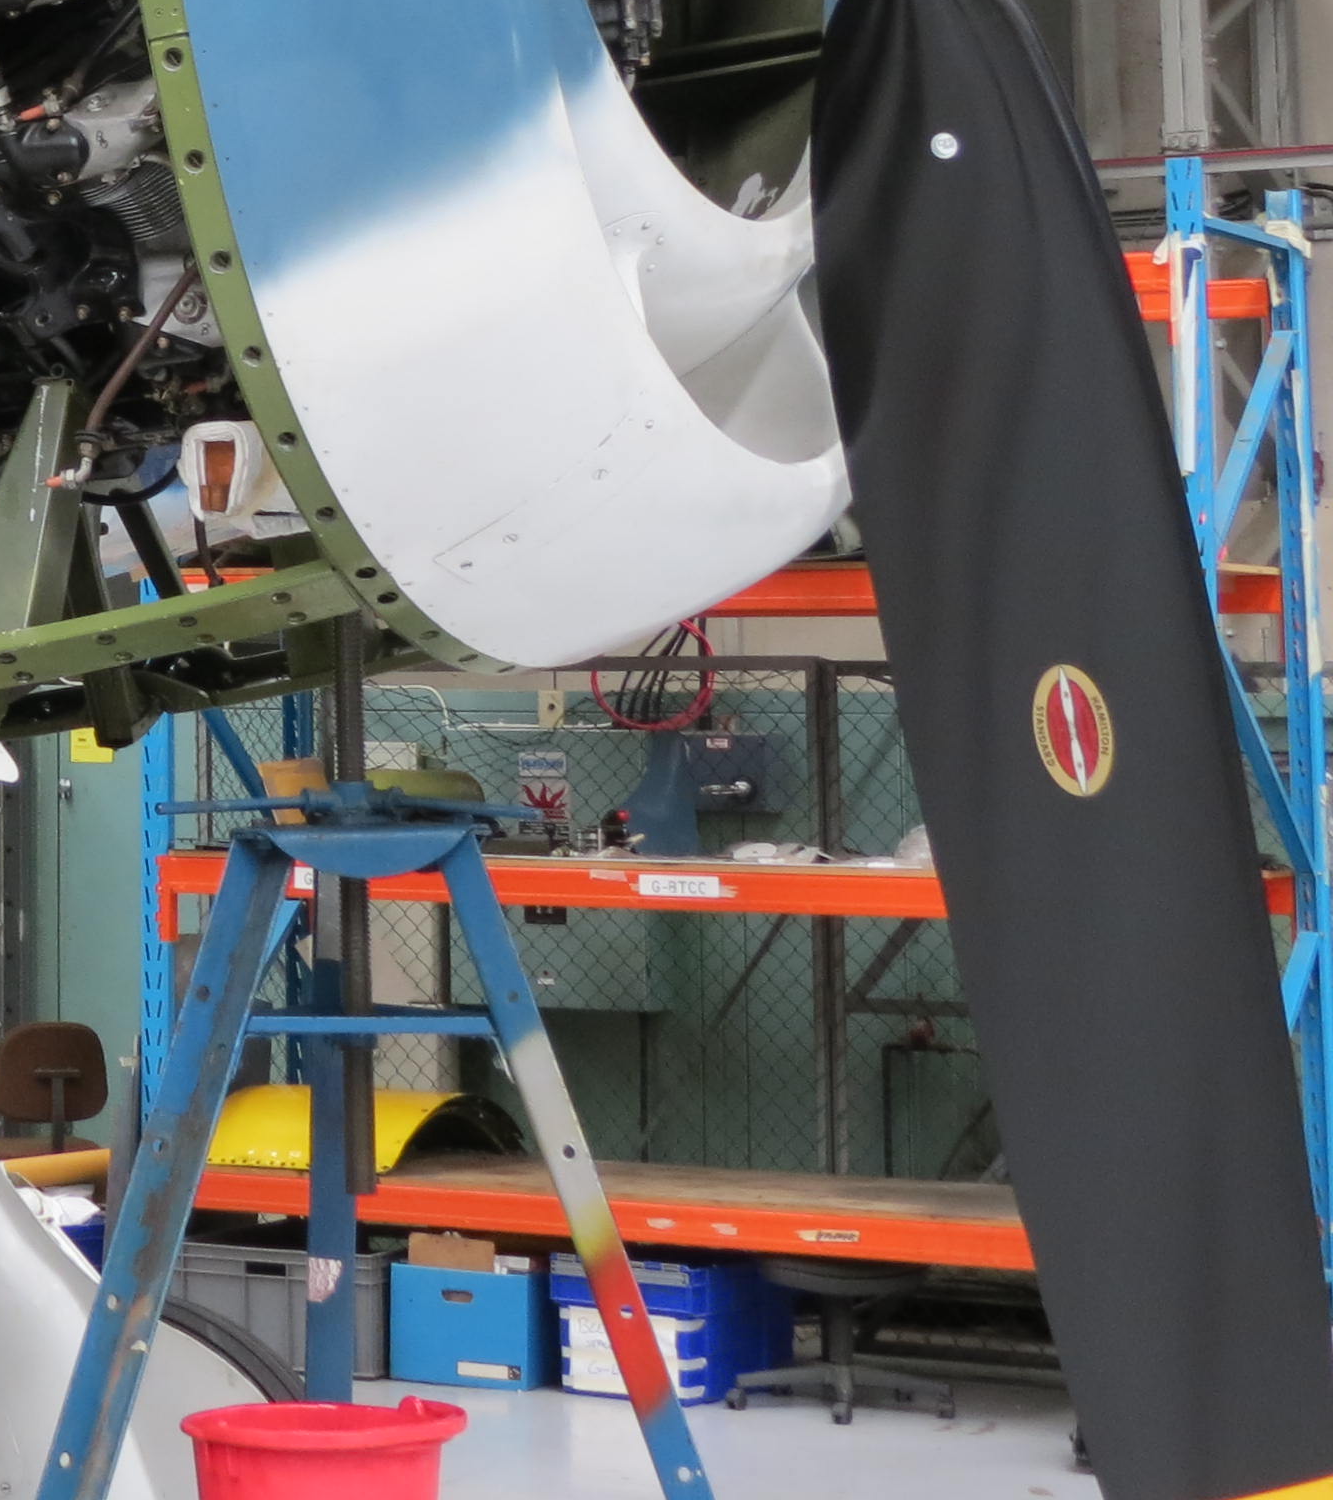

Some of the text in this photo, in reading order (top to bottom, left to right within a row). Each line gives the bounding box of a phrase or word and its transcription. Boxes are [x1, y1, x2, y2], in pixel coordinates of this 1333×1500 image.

[1035, 705, 1056, 767] STANDARD
[1091, 695, 1110, 756] HAMILTON
[650, 879, 708, 896] G-BTCC
